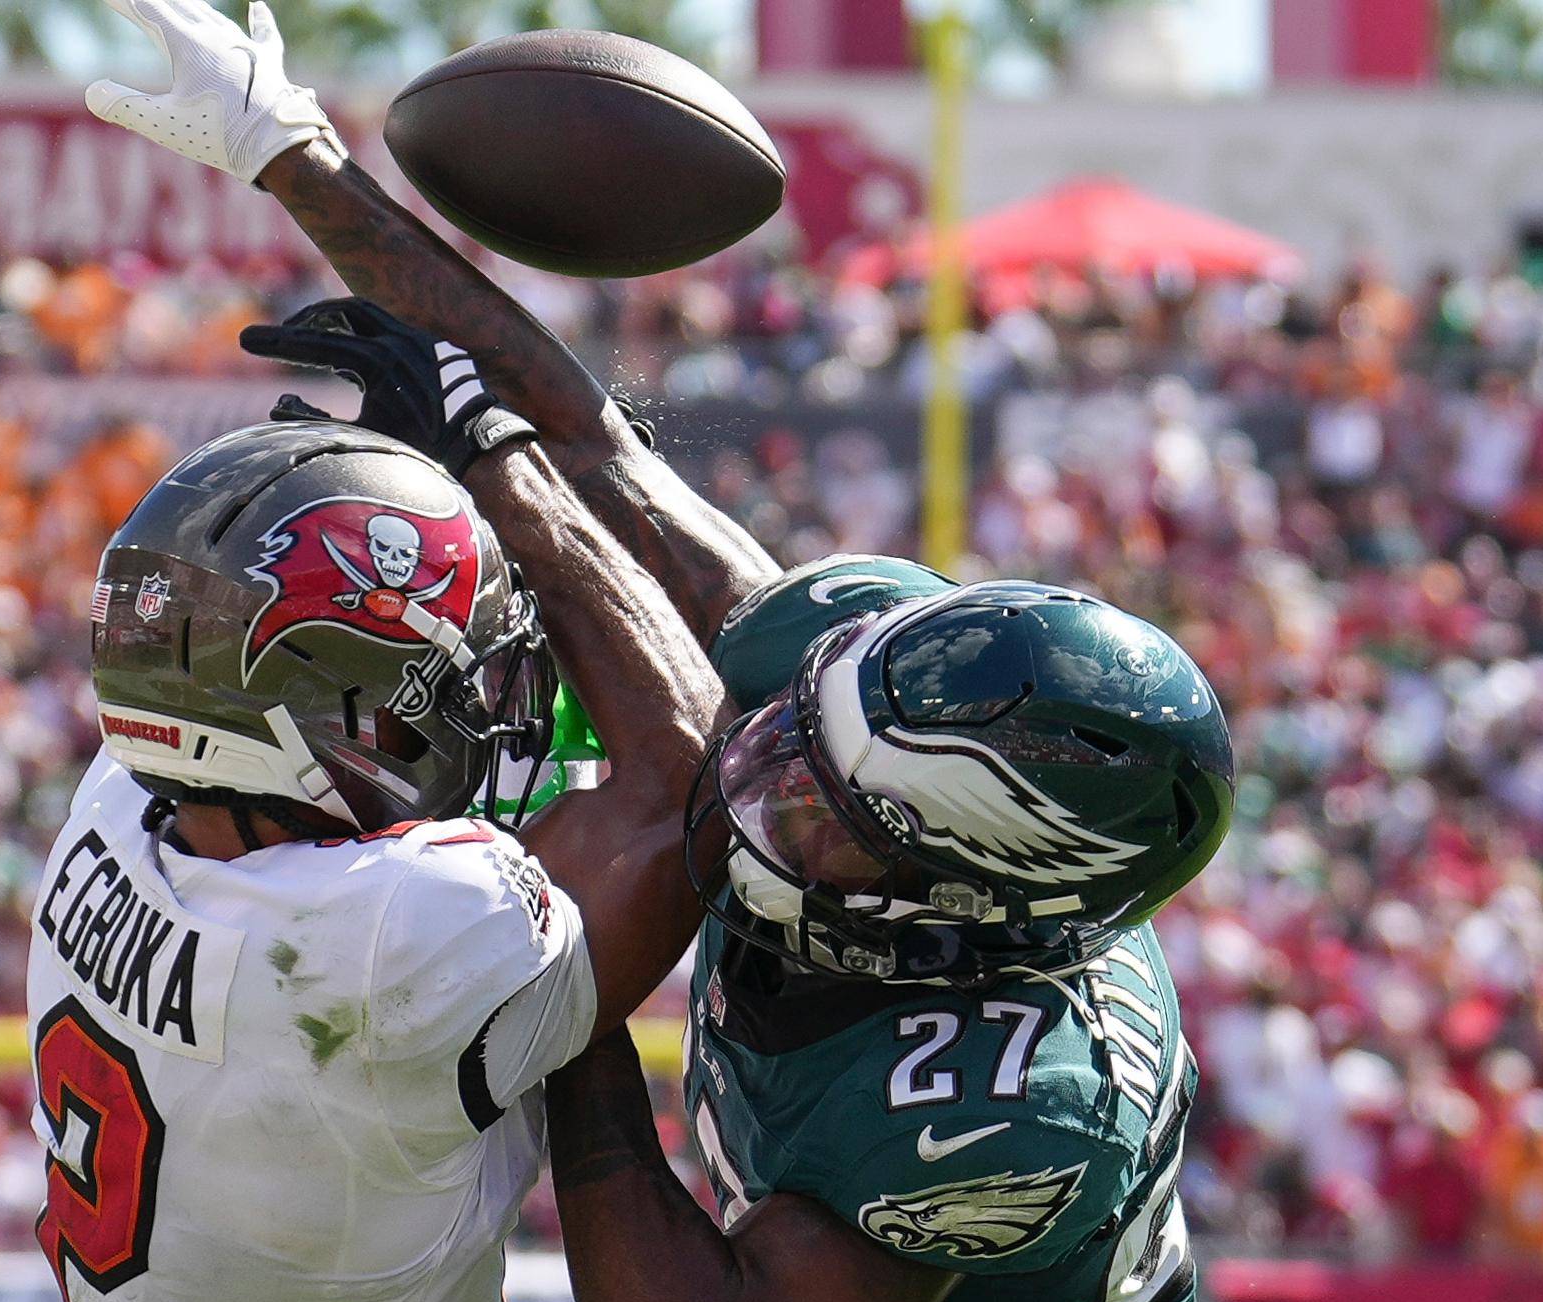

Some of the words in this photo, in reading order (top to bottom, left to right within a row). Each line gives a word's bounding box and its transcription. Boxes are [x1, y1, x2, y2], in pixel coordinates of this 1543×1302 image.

[140, 592, 162, 614] NFL
[865, 795, 910, 845] OAKLEY
[38, 827, 201, 1047] EGBUKA
[887, 999, 1051, 1114] 27
